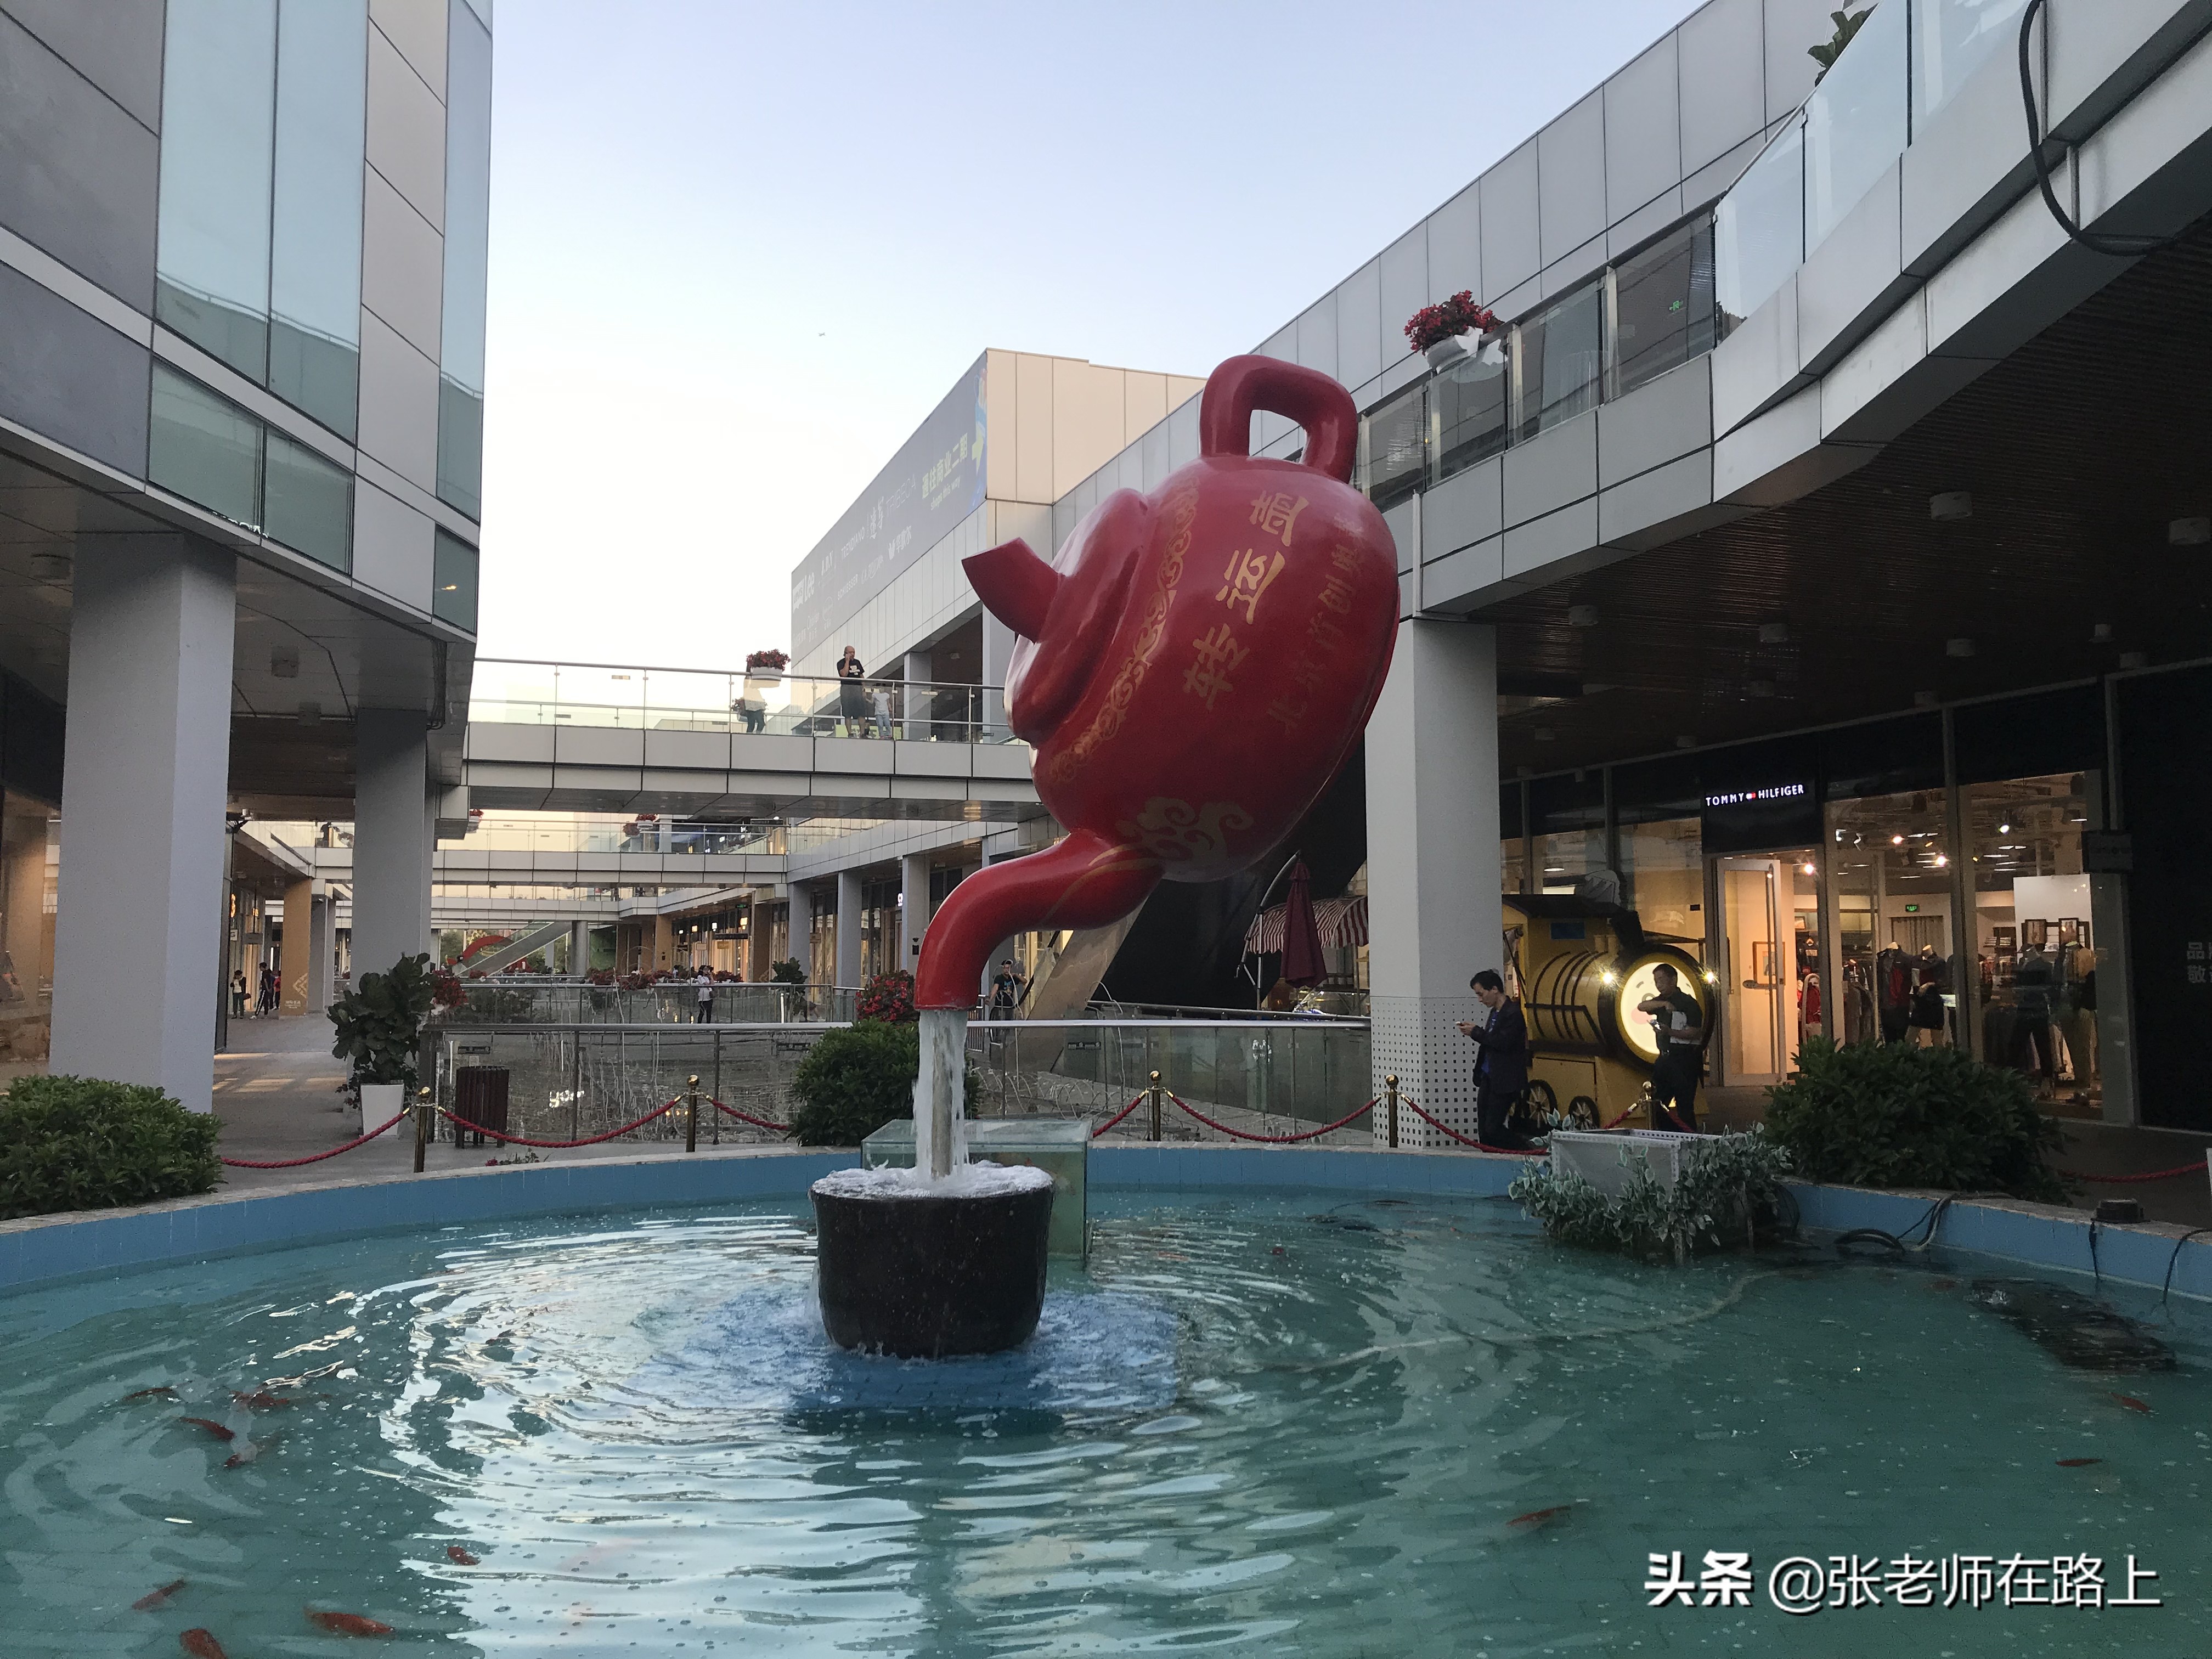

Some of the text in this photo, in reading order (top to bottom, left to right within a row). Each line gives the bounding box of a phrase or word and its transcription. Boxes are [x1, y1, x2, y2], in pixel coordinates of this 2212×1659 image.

[922, 432, 967, 499] 通往商业二期
[886, 473, 916, 517] TRIBECA
[931, 493, 943, 511] shops
[951, 476, 960, 492] way
[841, 527, 865, 560] TRENDIANO
[805, 572, 815, 602] Lee
[837, 574, 858, 601] SCHIESSER
[1183, 490, 1309, 712] 转运壶
[1706, 784, 1804, 806] TOMMY HILFIGER
[2187, 941, 2212, 960] 品
[2187, 964, 2212, 983] 敬
